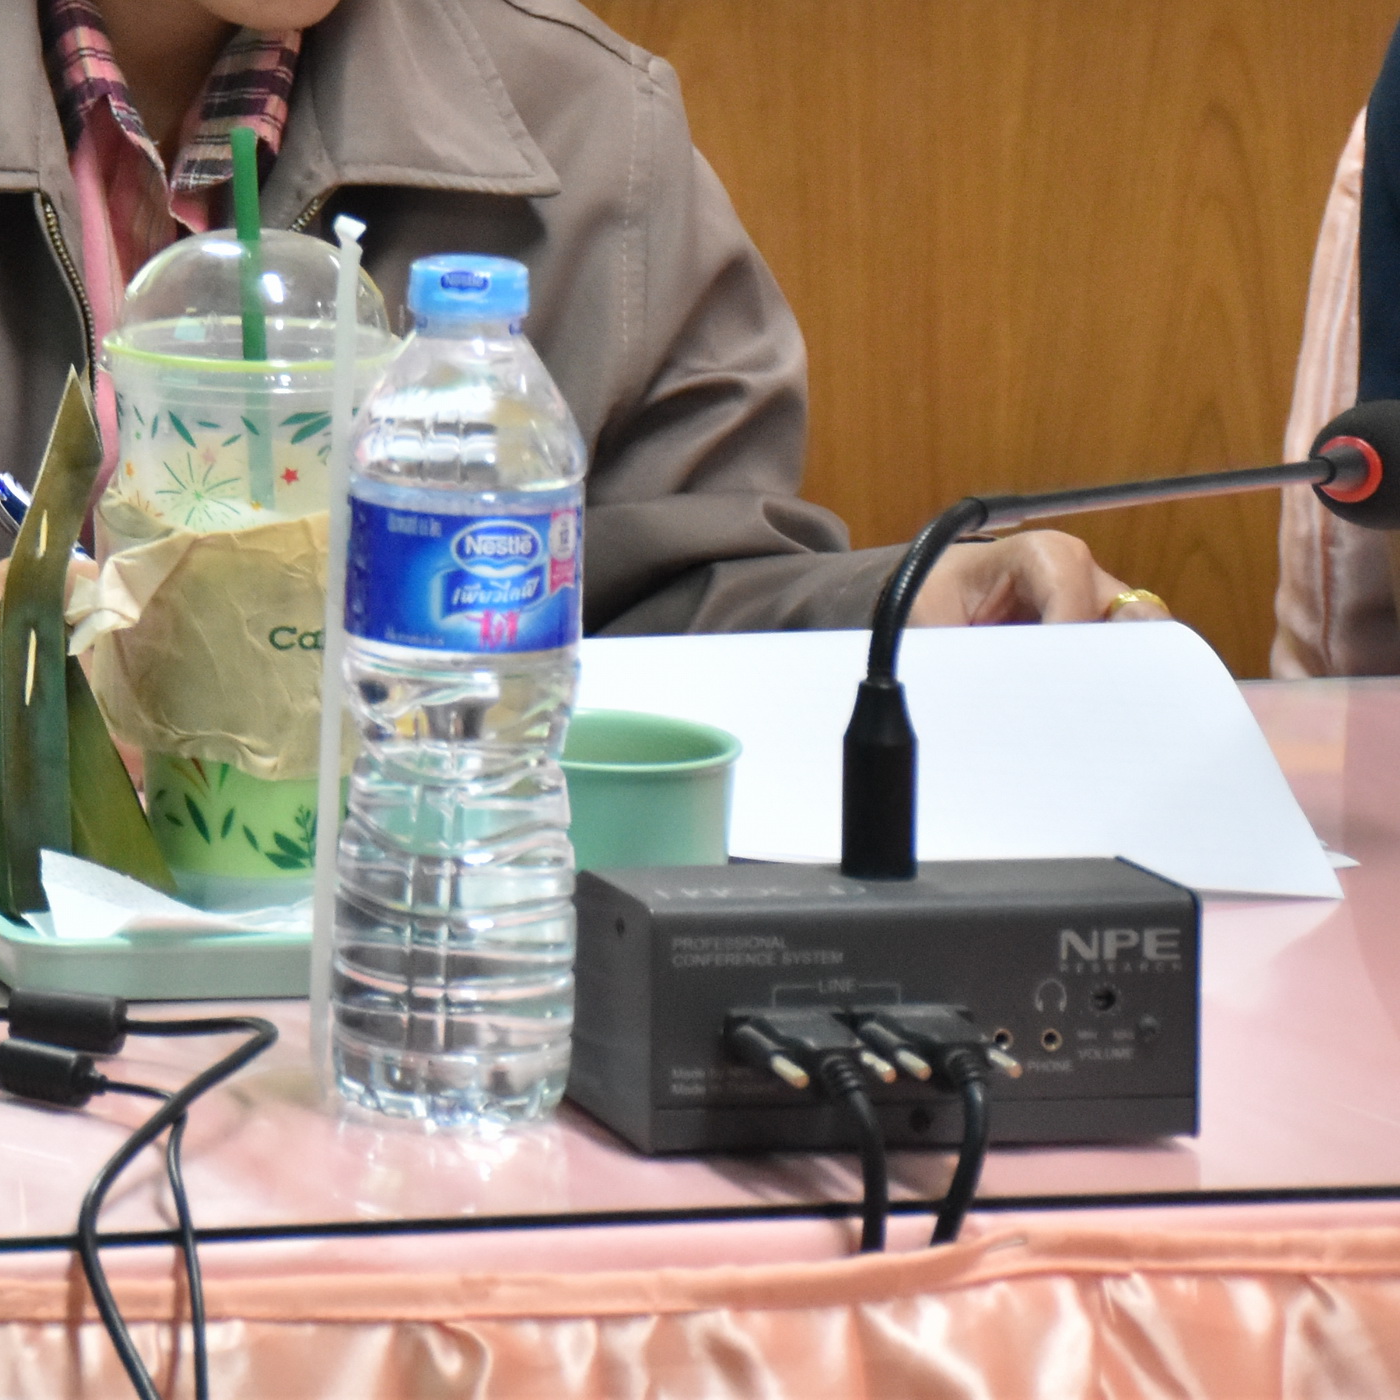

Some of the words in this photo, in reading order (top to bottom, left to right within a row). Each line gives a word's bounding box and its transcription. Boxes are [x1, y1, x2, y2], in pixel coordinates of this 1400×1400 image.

[671, 935, 787, 952] PROFESSIONAL
[1059, 928, 1182, 961] NPE
[671, 951, 777, 968] CONFERENCE
[782, 950, 844, 965] SYSTEM
[1059, 962, 1183, 973] RESEARCH
[818, 978, 856, 994] LINE
